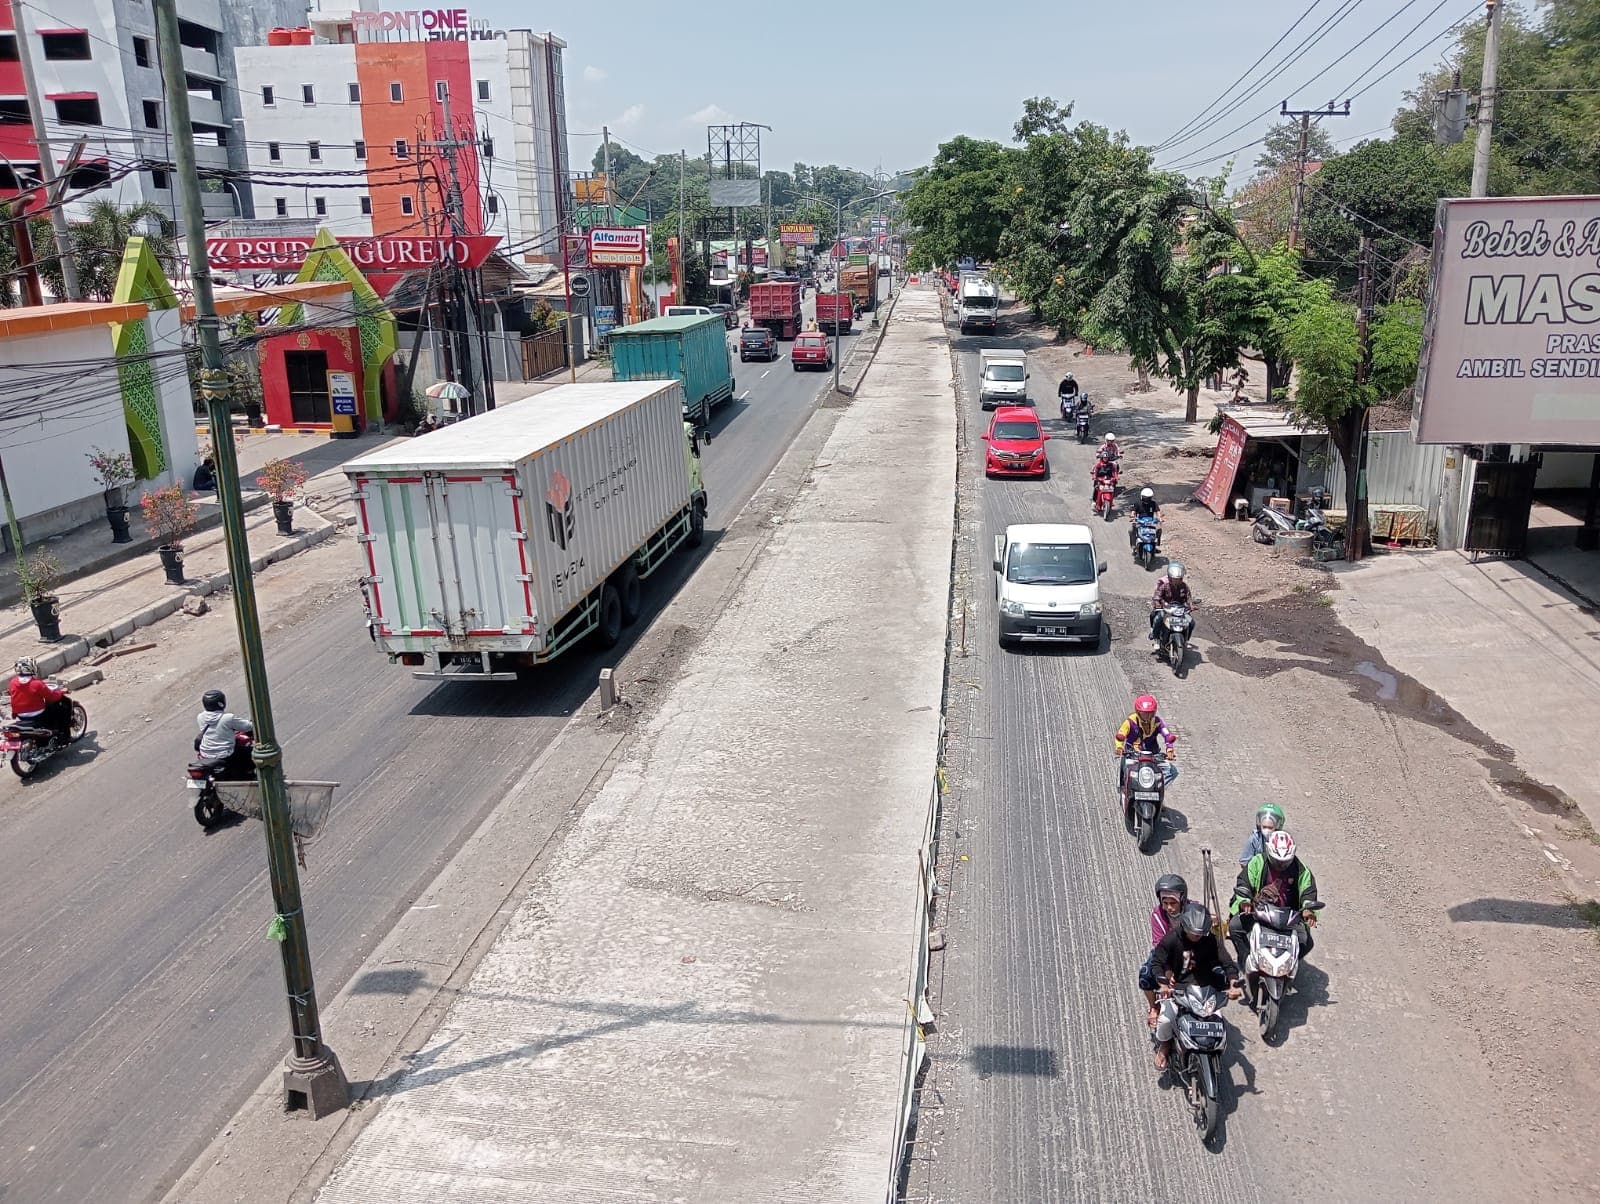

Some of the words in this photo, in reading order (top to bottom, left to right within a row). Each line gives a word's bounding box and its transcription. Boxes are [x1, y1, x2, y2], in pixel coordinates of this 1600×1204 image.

[594, 232, 639, 242] Alfamart
[1462, 219, 1551, 259] Bebek
[1554, 220, 1576, 259] &
[1576, 216, 1600, 269] A
[237, 241, 309, 264] RSUD
[1464, 273, 1600, 324] MAS
[1456, 358, 1525, 378] AMBIL
[1530, 358, 1600, 378] SENDI
